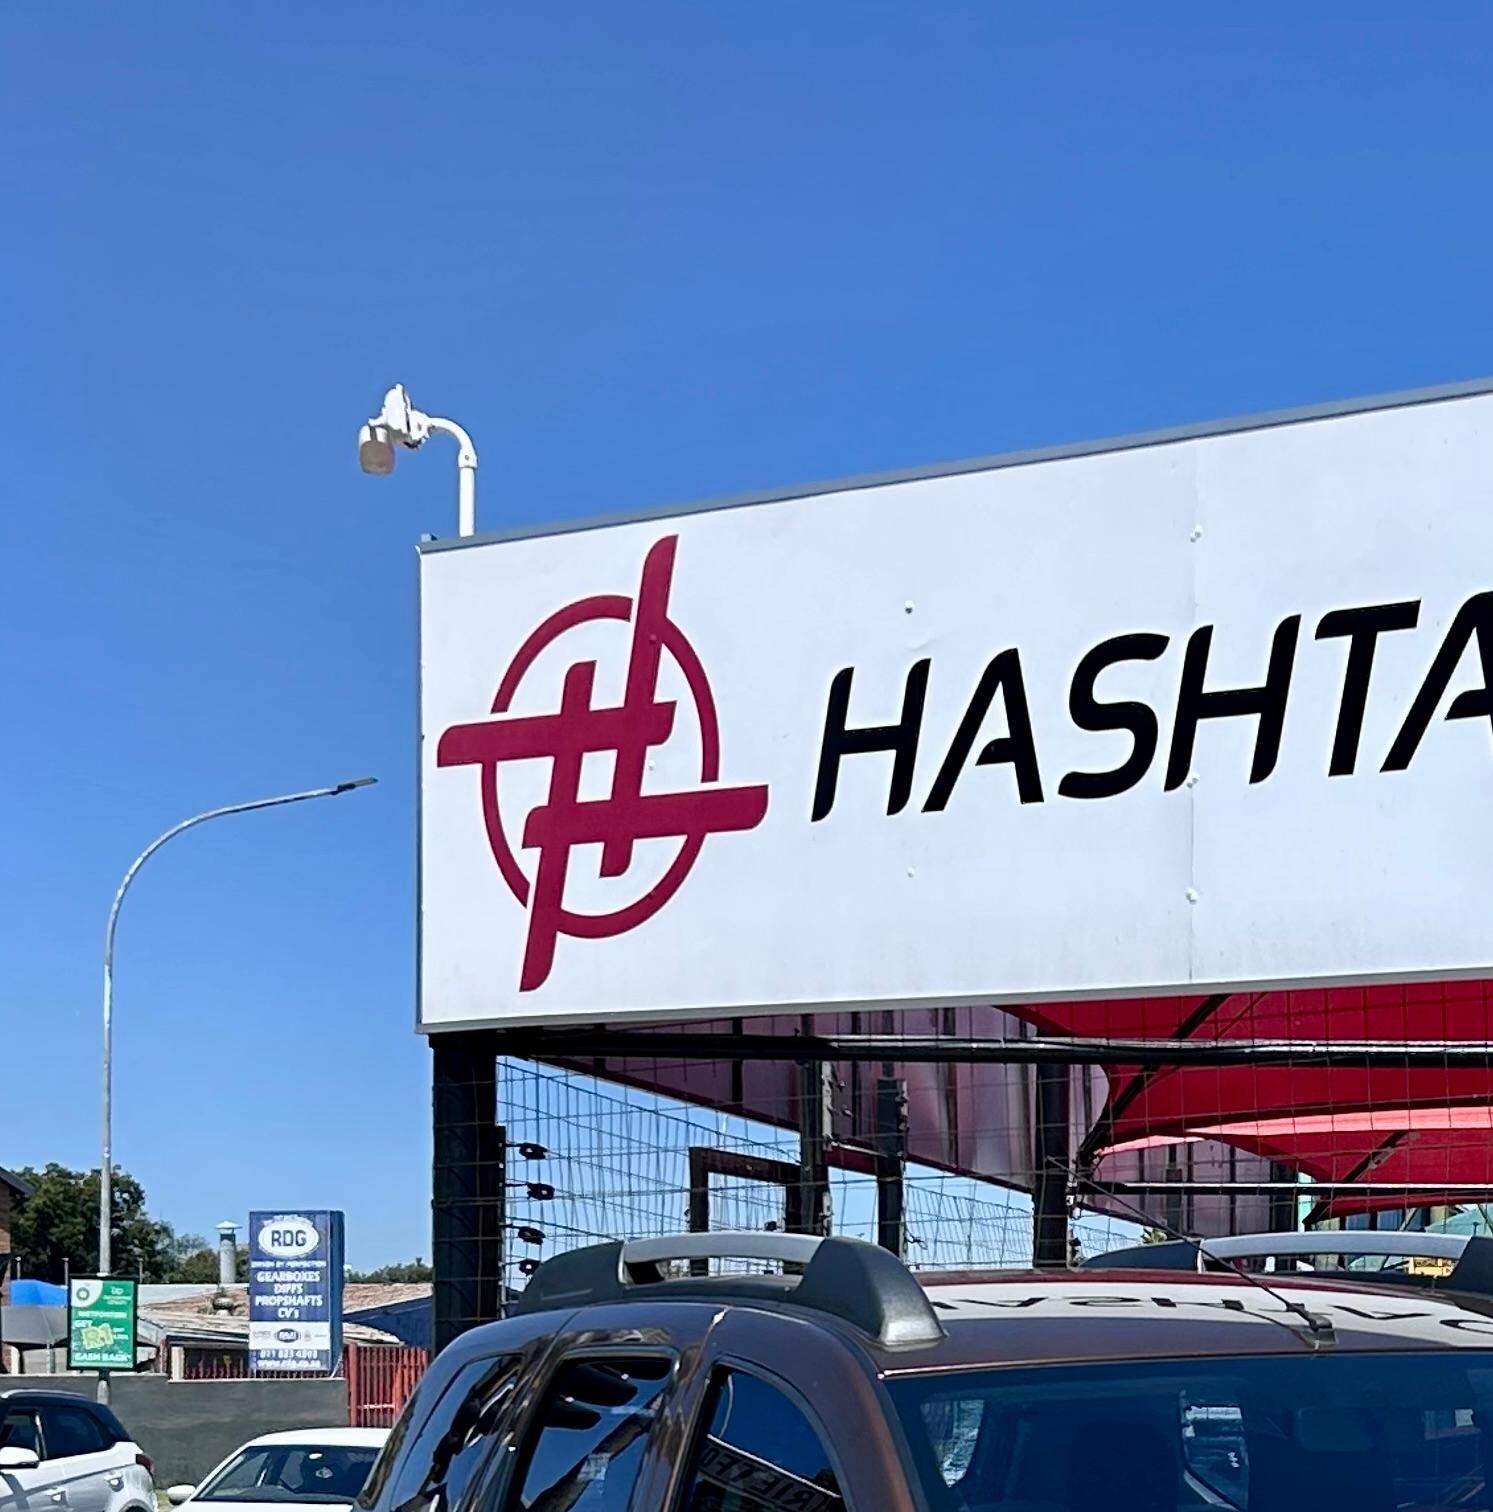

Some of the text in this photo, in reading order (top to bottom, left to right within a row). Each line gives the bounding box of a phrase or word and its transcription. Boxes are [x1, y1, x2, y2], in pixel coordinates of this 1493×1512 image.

[271, 1229, 307, 1247] RDG
[256, 1270, 321, 1283] GEARBOXES
[273, 1283, 304, 1295] DIFFS
[255, 1294, 323, 1307] PROPSHAFTS
